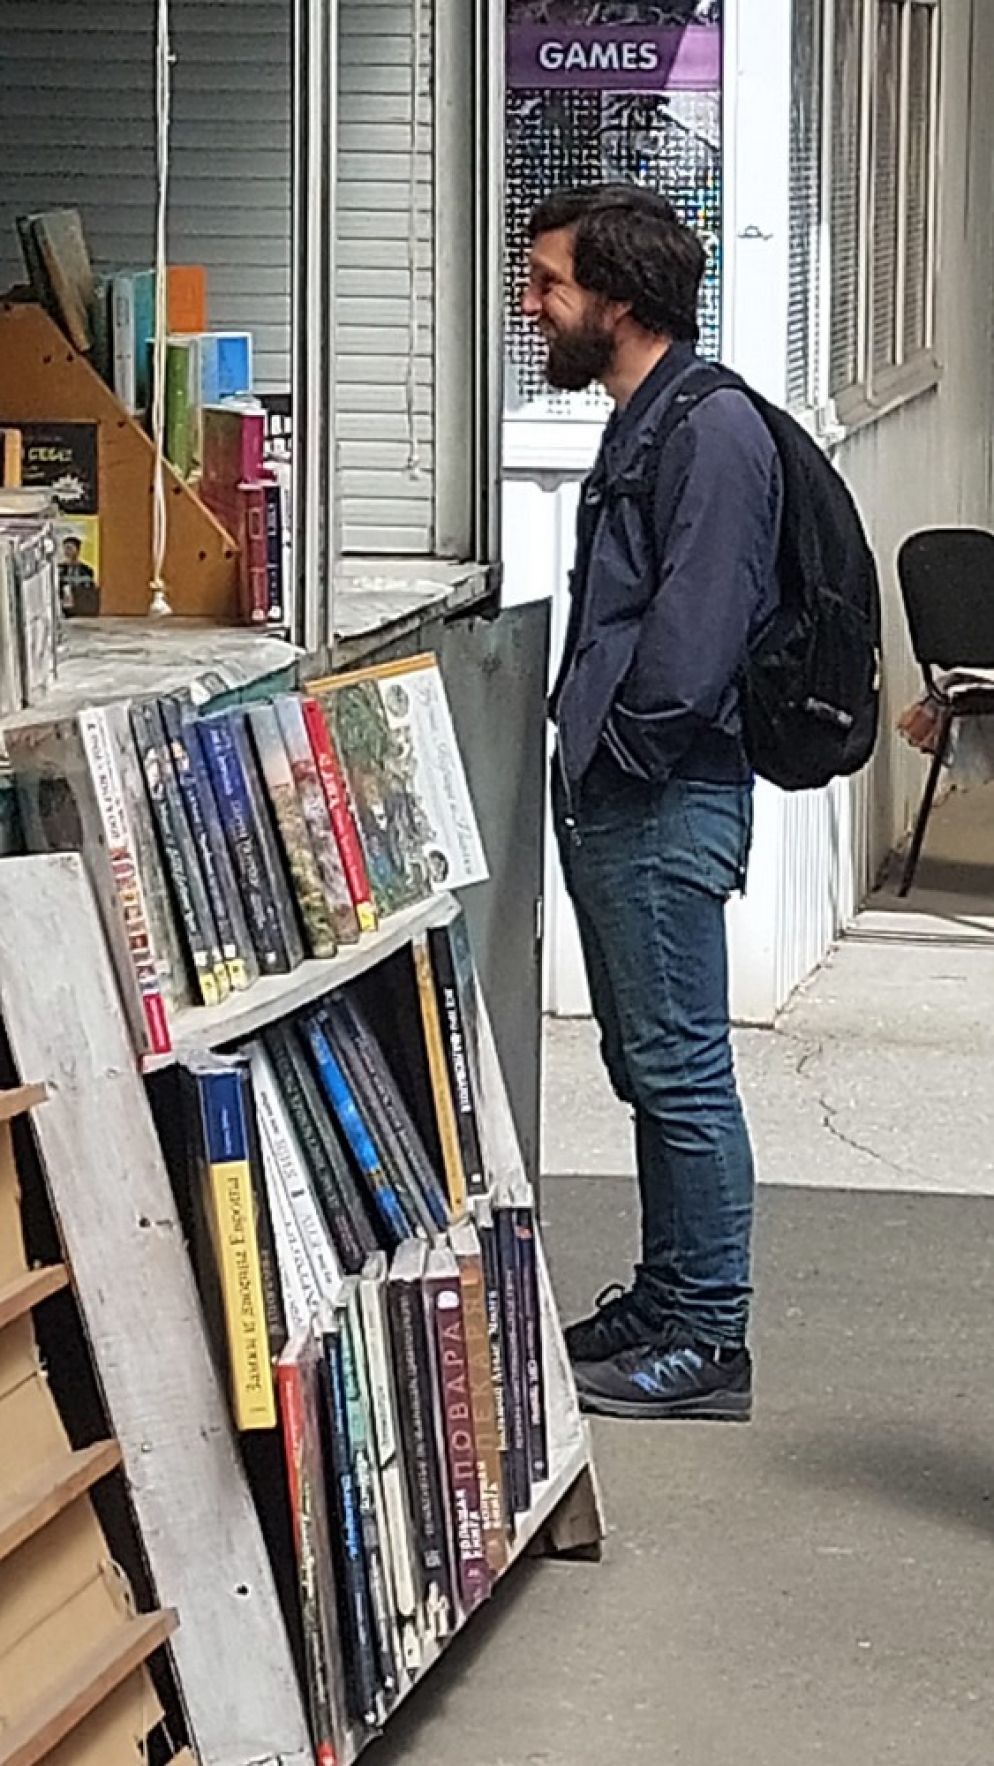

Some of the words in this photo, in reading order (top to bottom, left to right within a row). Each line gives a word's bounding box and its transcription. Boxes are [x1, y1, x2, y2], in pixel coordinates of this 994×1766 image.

[538, 41, 659, 71] GAMES
[443, 1321, 474, 1480] ПОВАРА
[464, 1298, 492, 1448] ПЕКАРЯ
